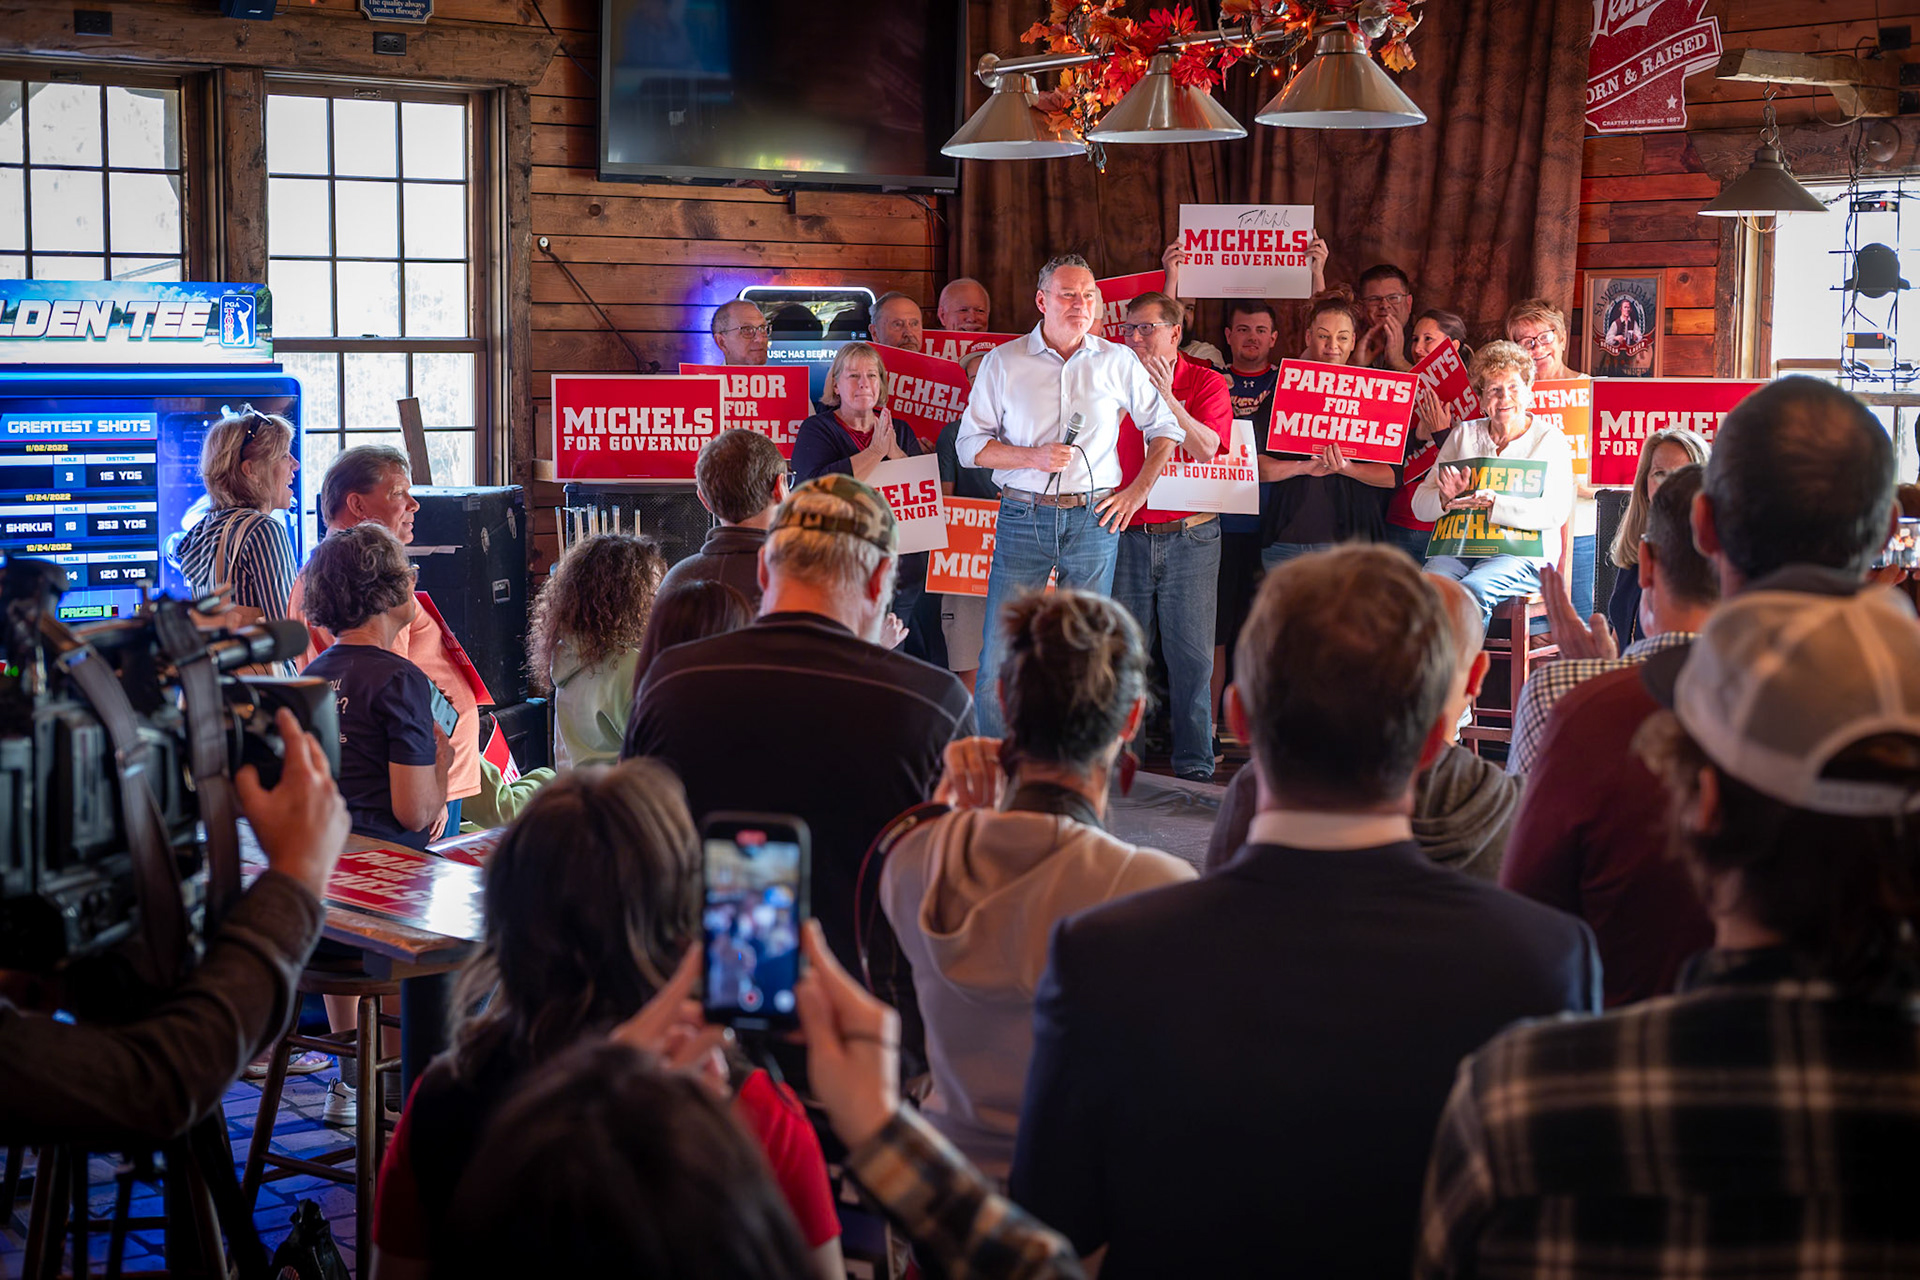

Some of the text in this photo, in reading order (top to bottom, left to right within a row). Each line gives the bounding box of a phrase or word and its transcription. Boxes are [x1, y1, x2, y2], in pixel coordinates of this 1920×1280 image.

[381, 0, 403, 8] quality
[1586, 33, 1708, 105] ORN & RAISED
[1184, 228, 1308, 253] MICHELS
[1184, 253, 1307, 267] FOR GOVERNOR
[1594, 282, 1626, 317] SAMUEL
[0, 299, 213, 338] LDEN TEE
[223, 307, 235, 343] TOUR
[767, 350, 787, 359] USIC
[788, 350, 805, 359] HAS
[806, 349, 827, 359] BEEN
[1415, 346, 1460, 405] ENTS
[724, 374, 787, 398] BOR
[886, 371, 966, 412] ICHEL
[1281, 367, 1412, 403] PARENTS
[724, 400, 759, 417] FOR
[893, 398, 963, 423] GOVERN
[1323, 397, 1360, 416] FOR
[7, 420, 151, 434] GREATEST SHOTS
[563, 407, 714, 435] MICHELS
[1273, 411, 1403, 448] MICHELS
[1540, 413, 1565, 430] OR
[1600, 410, 1729, 438] MICHE
[25, 444, 69, 452] 11/02/2022
[563, 436, 601, 451] FOR
[1600, 440, 1638, 456] FOR
[65, 472, 74, 482] 3
[118, 470, 143, 480] YDS
[1161, 464, 1255, 482] OR GOVERNOR
[1464, 466, 1542, 493] MERS
[25, 493, 72, 502] 10/24/2022
[894, 505, 939, 522] RNOR
[943, 506, 998, 528] SPORT
[5, 522, 53, 533] SHAKUR
[97, 520, 119, 530] 353
[123, 519, 147, 530] YDS
[26, 543, 72, 552] 10/24/2022
[100, 570, 118, 580] 120
[122, 569, 146, 579] YDS
[60, 606, 103, 619] PRIZES
